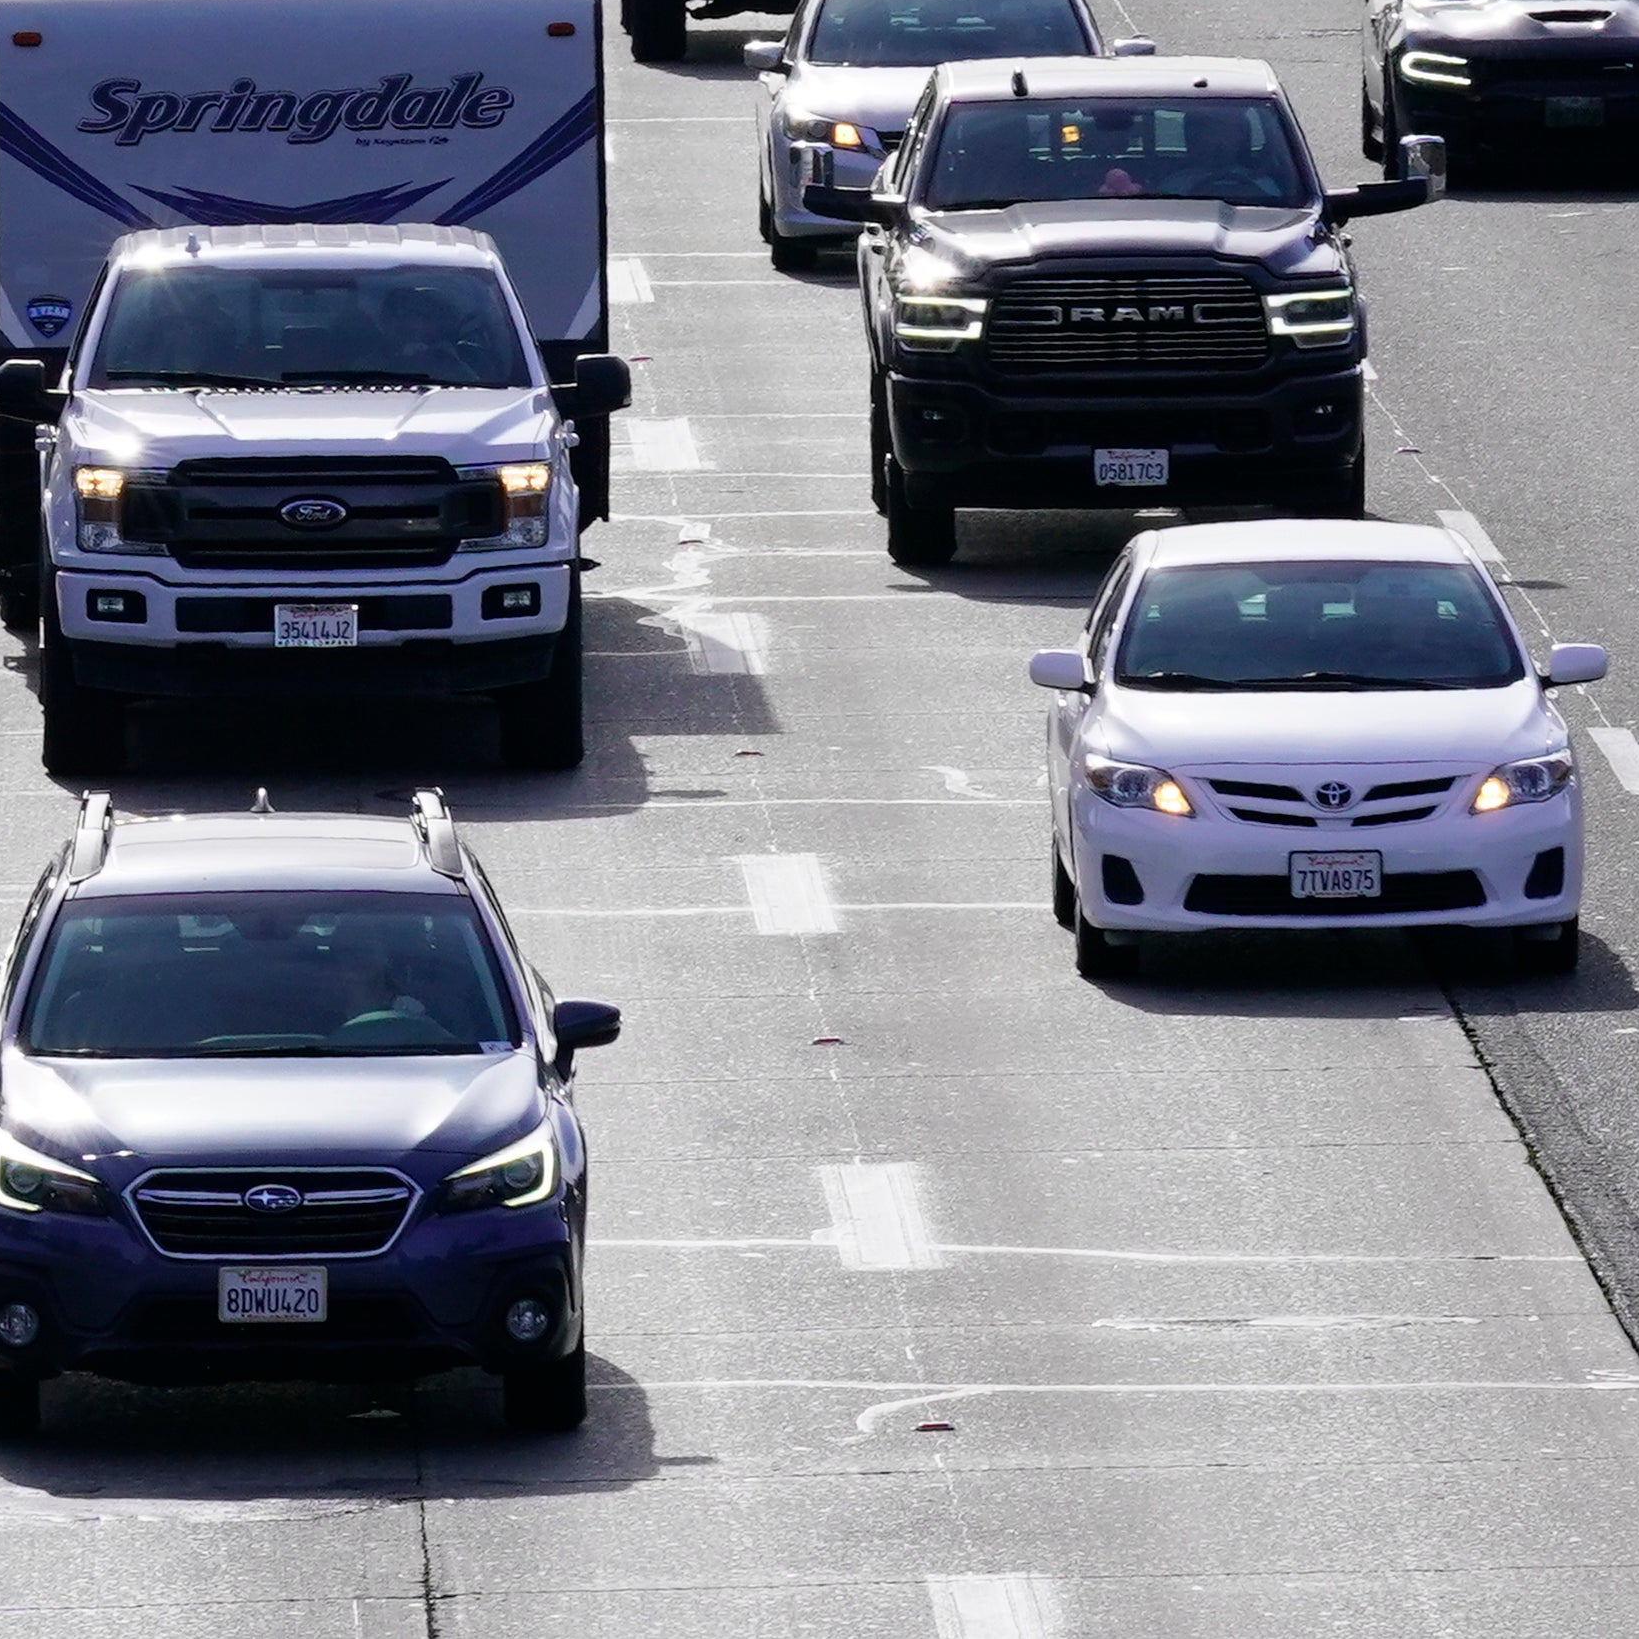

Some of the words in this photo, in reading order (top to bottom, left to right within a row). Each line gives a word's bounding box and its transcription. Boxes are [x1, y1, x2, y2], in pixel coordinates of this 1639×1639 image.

[77, 70, 515, 144] Springdale
[1070, 306, 1186, 323] RAM
[1100, 463, 1165, 481] 05817C3
[295, 505, 333, 521] Ford
[281, 621, 351, 639] 35414J2
[1298, 870, 1374, 892] 7TVA875
[227, 1288, 319, 1313] 8DWU420
